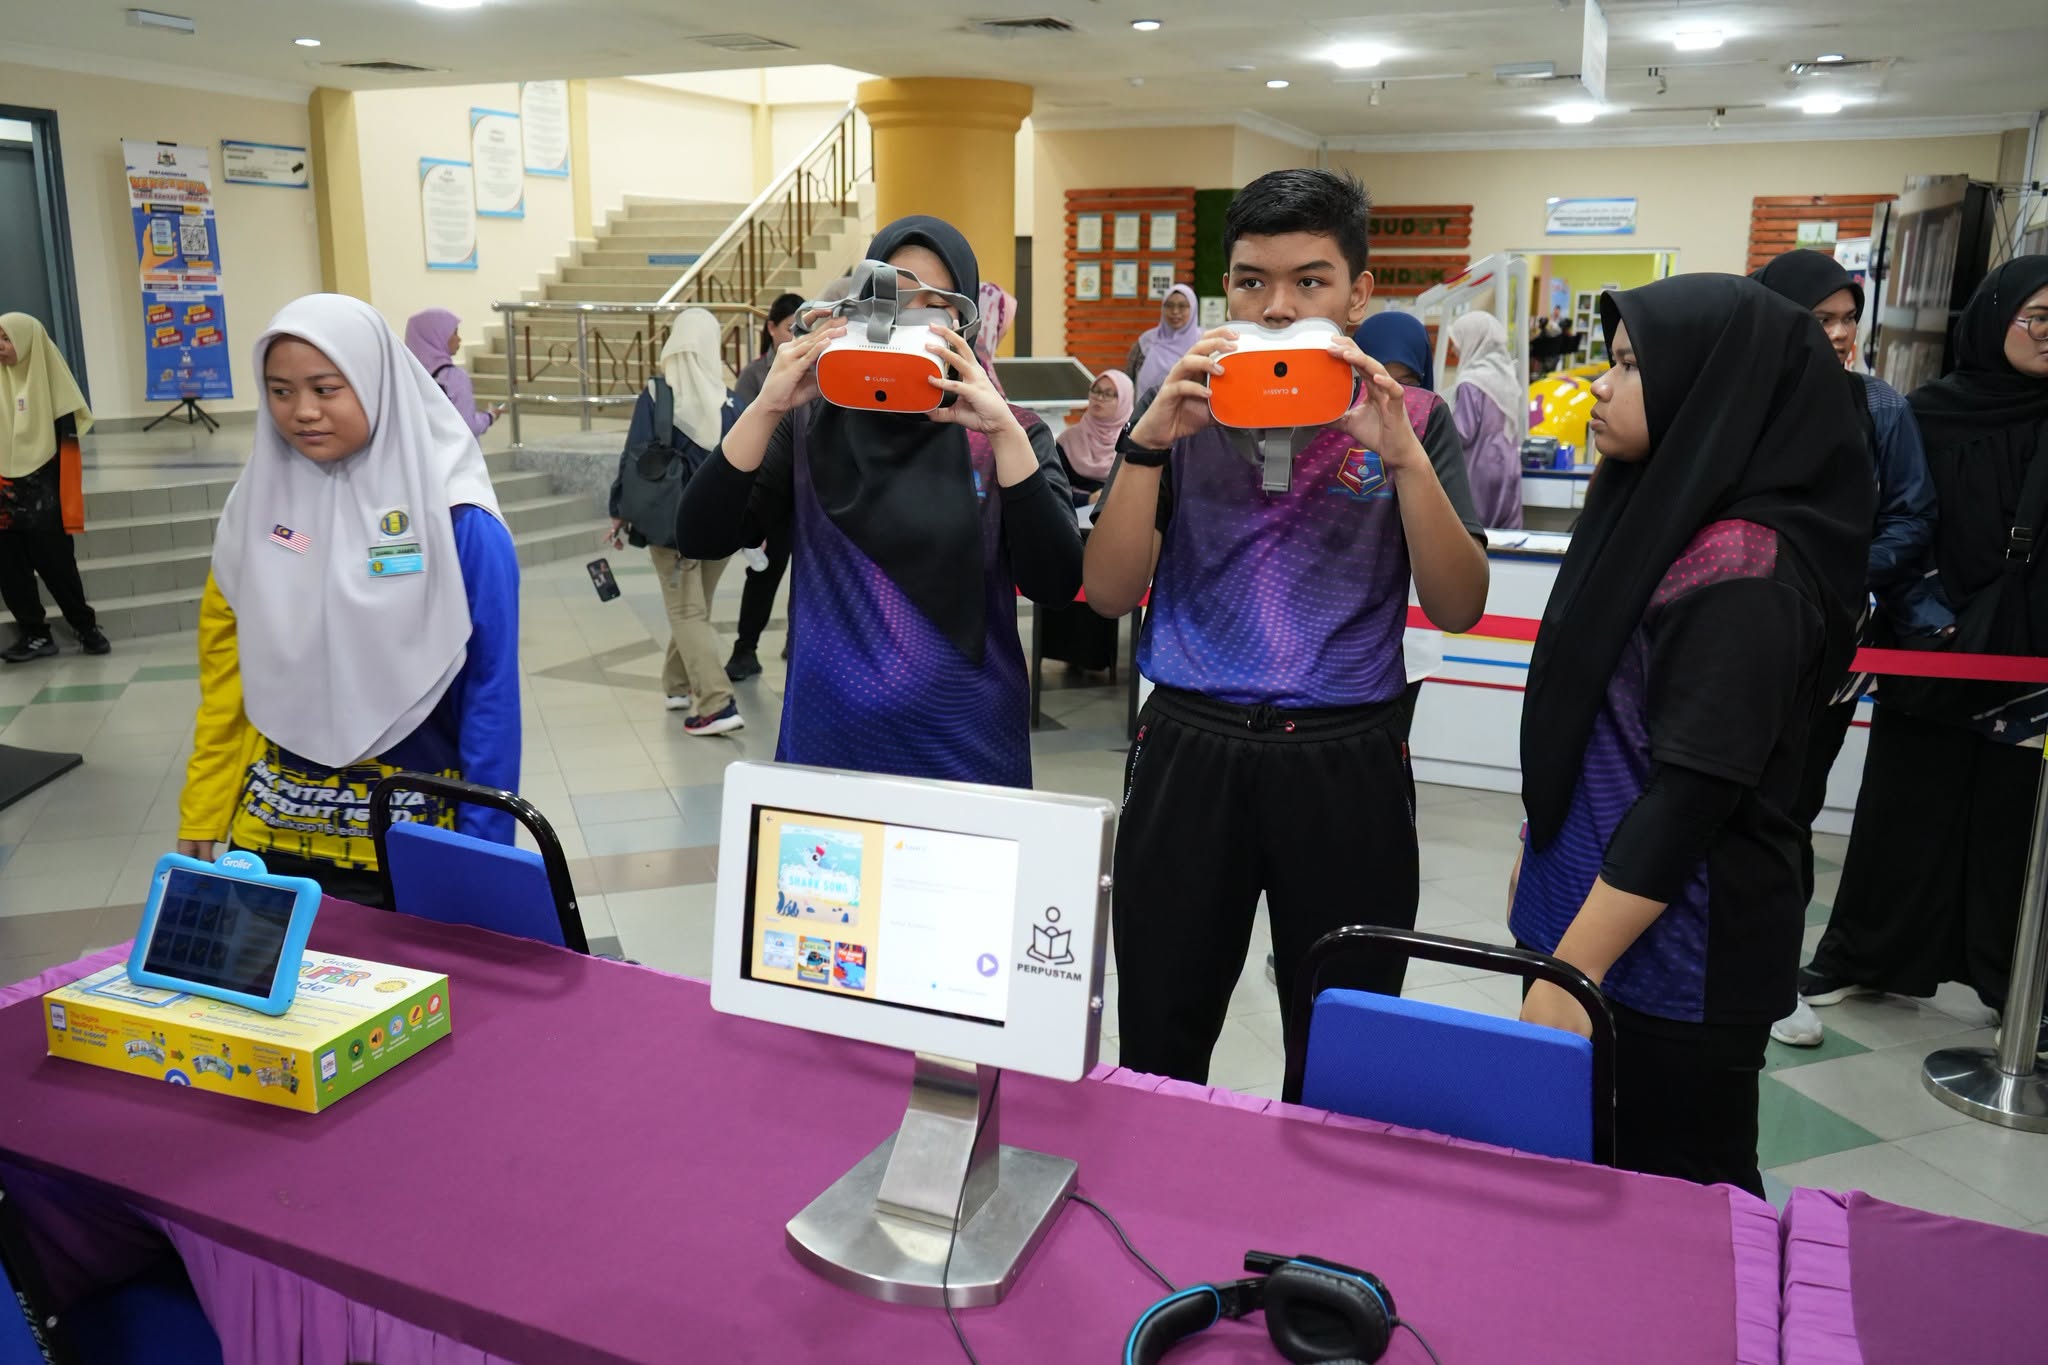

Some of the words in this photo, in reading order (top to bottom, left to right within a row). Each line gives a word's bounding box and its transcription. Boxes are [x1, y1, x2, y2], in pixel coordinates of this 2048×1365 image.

[247, 779, 338, 819] PRESINT
[278, 778, 426, 806] PUTRAJYA
[1017, 963, 1082, 981] PERPUSTAM
